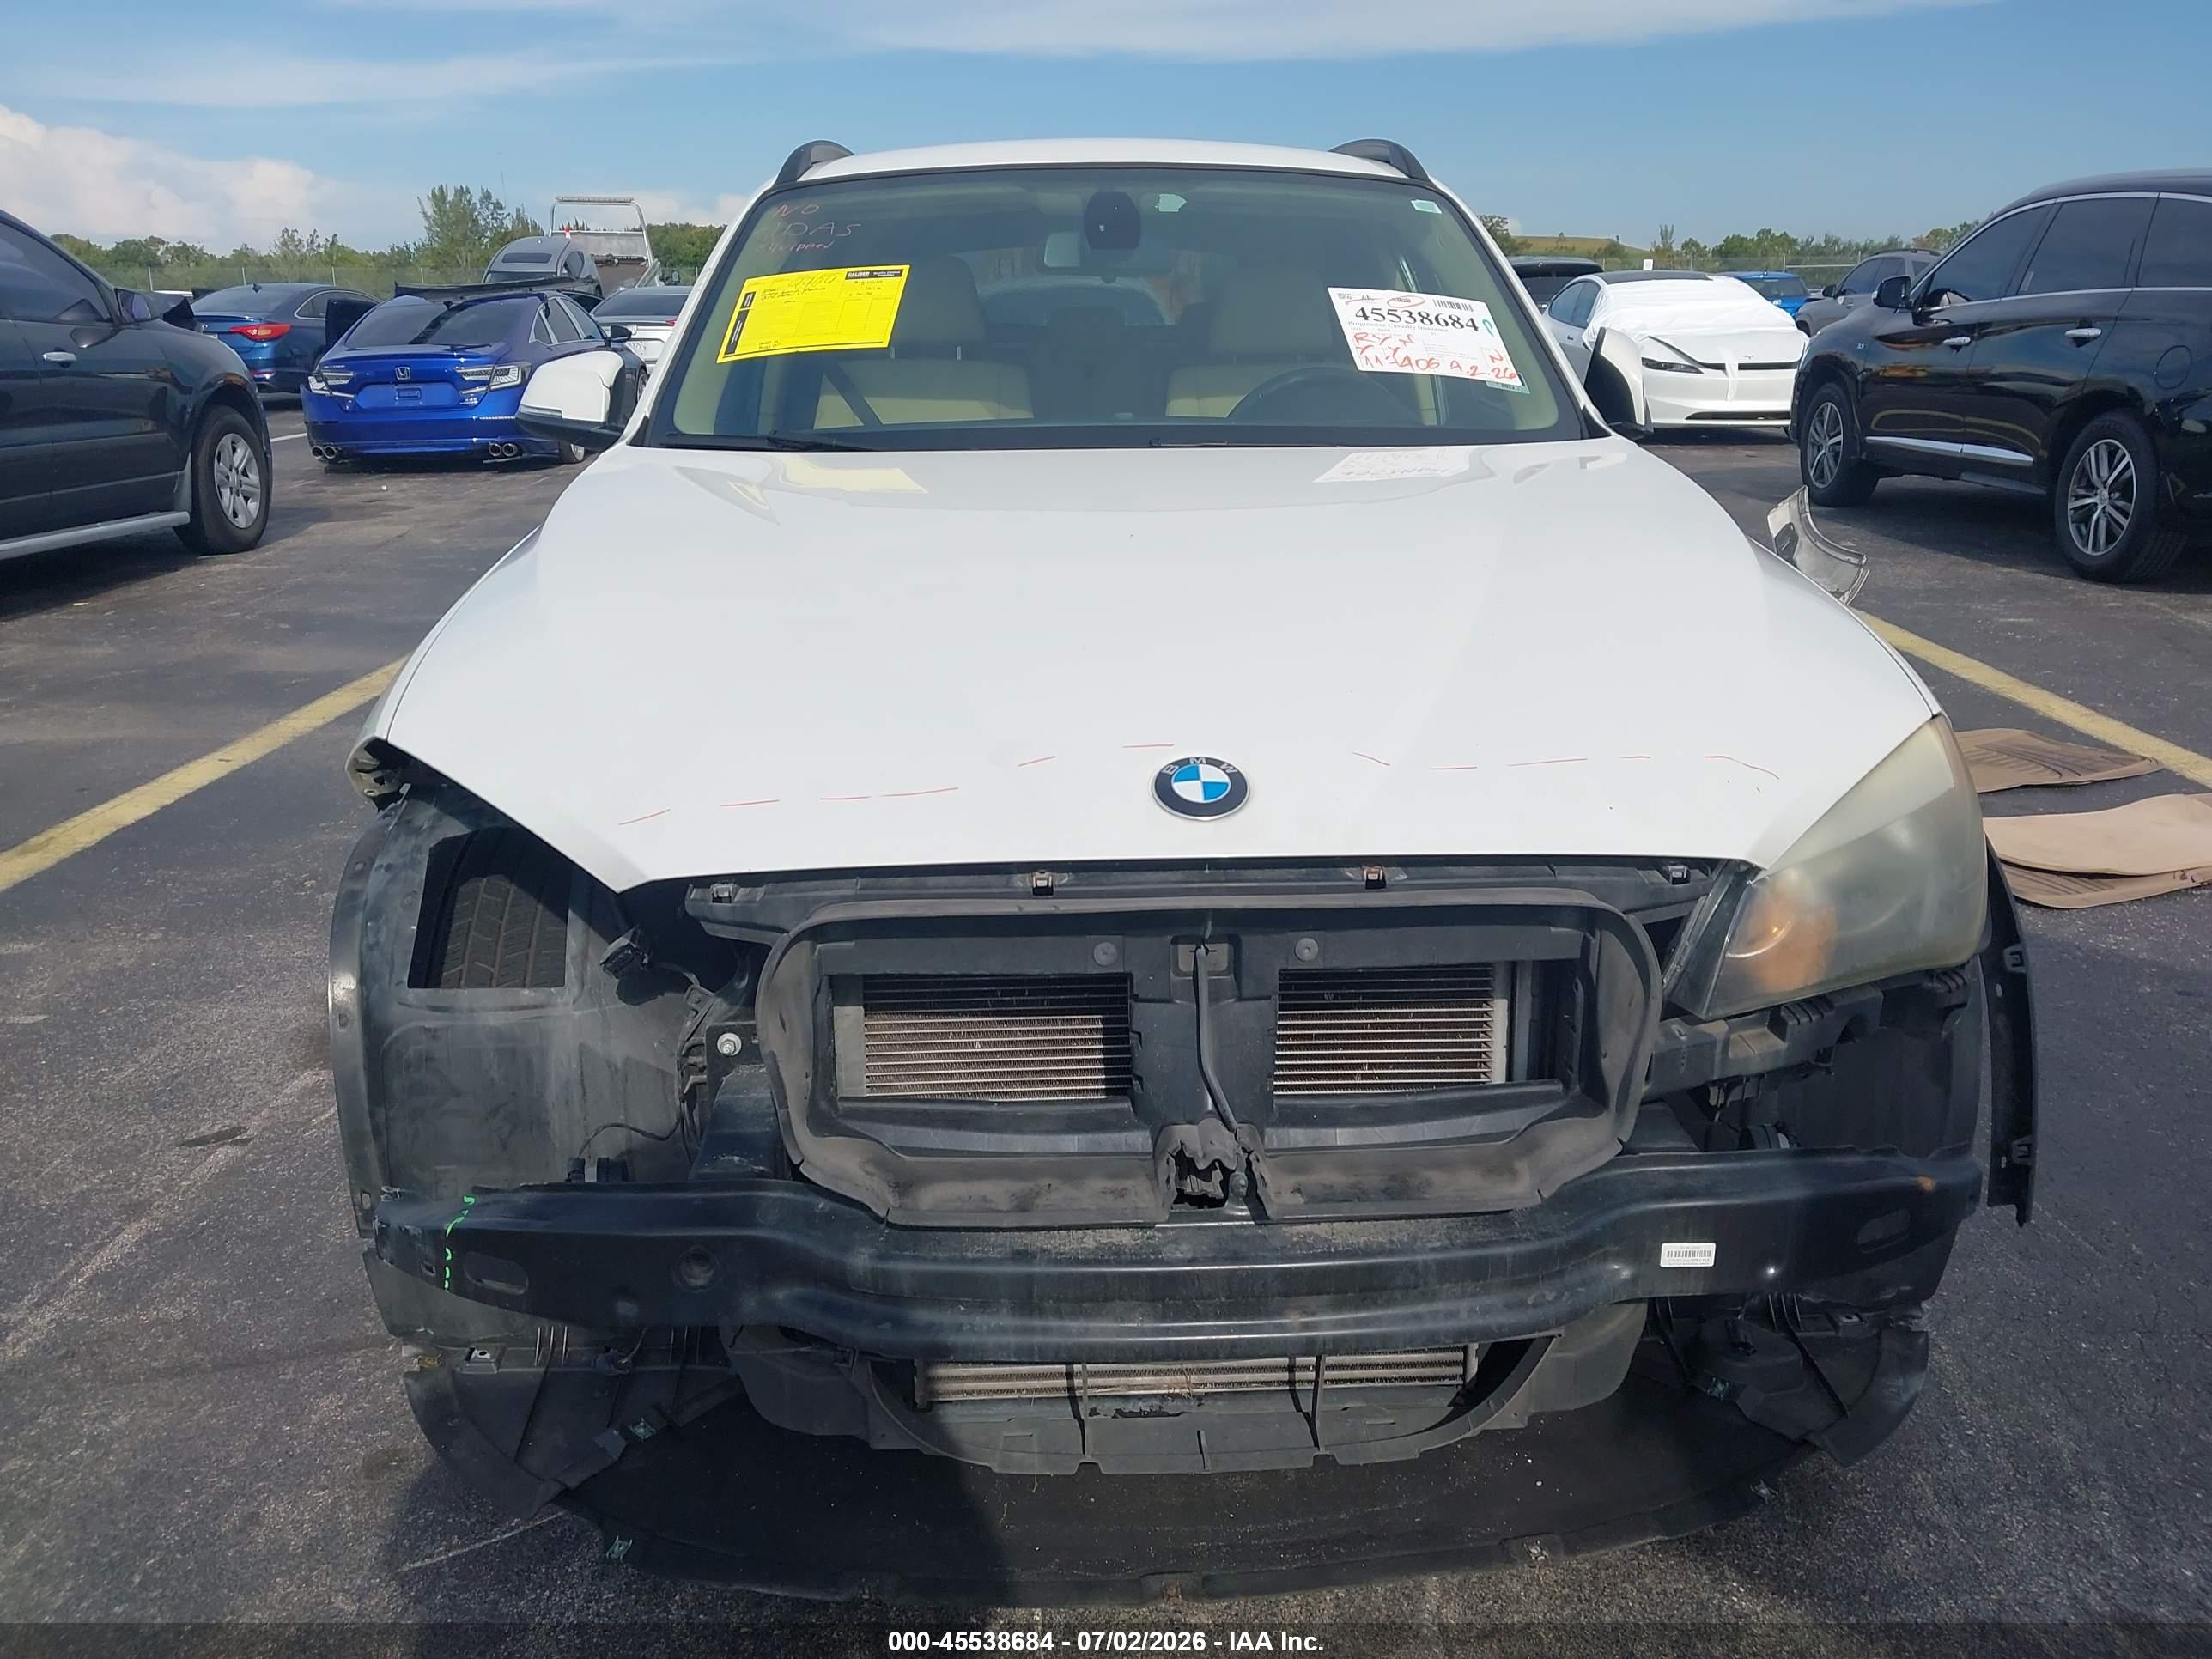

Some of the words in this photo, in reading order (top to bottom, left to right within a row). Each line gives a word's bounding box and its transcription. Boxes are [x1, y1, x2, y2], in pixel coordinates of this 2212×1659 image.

[774, 204, 820, 217] NO
[1355, 307, 1479, 332] 45538684
[1161, 756, 1238, 775] BMW
